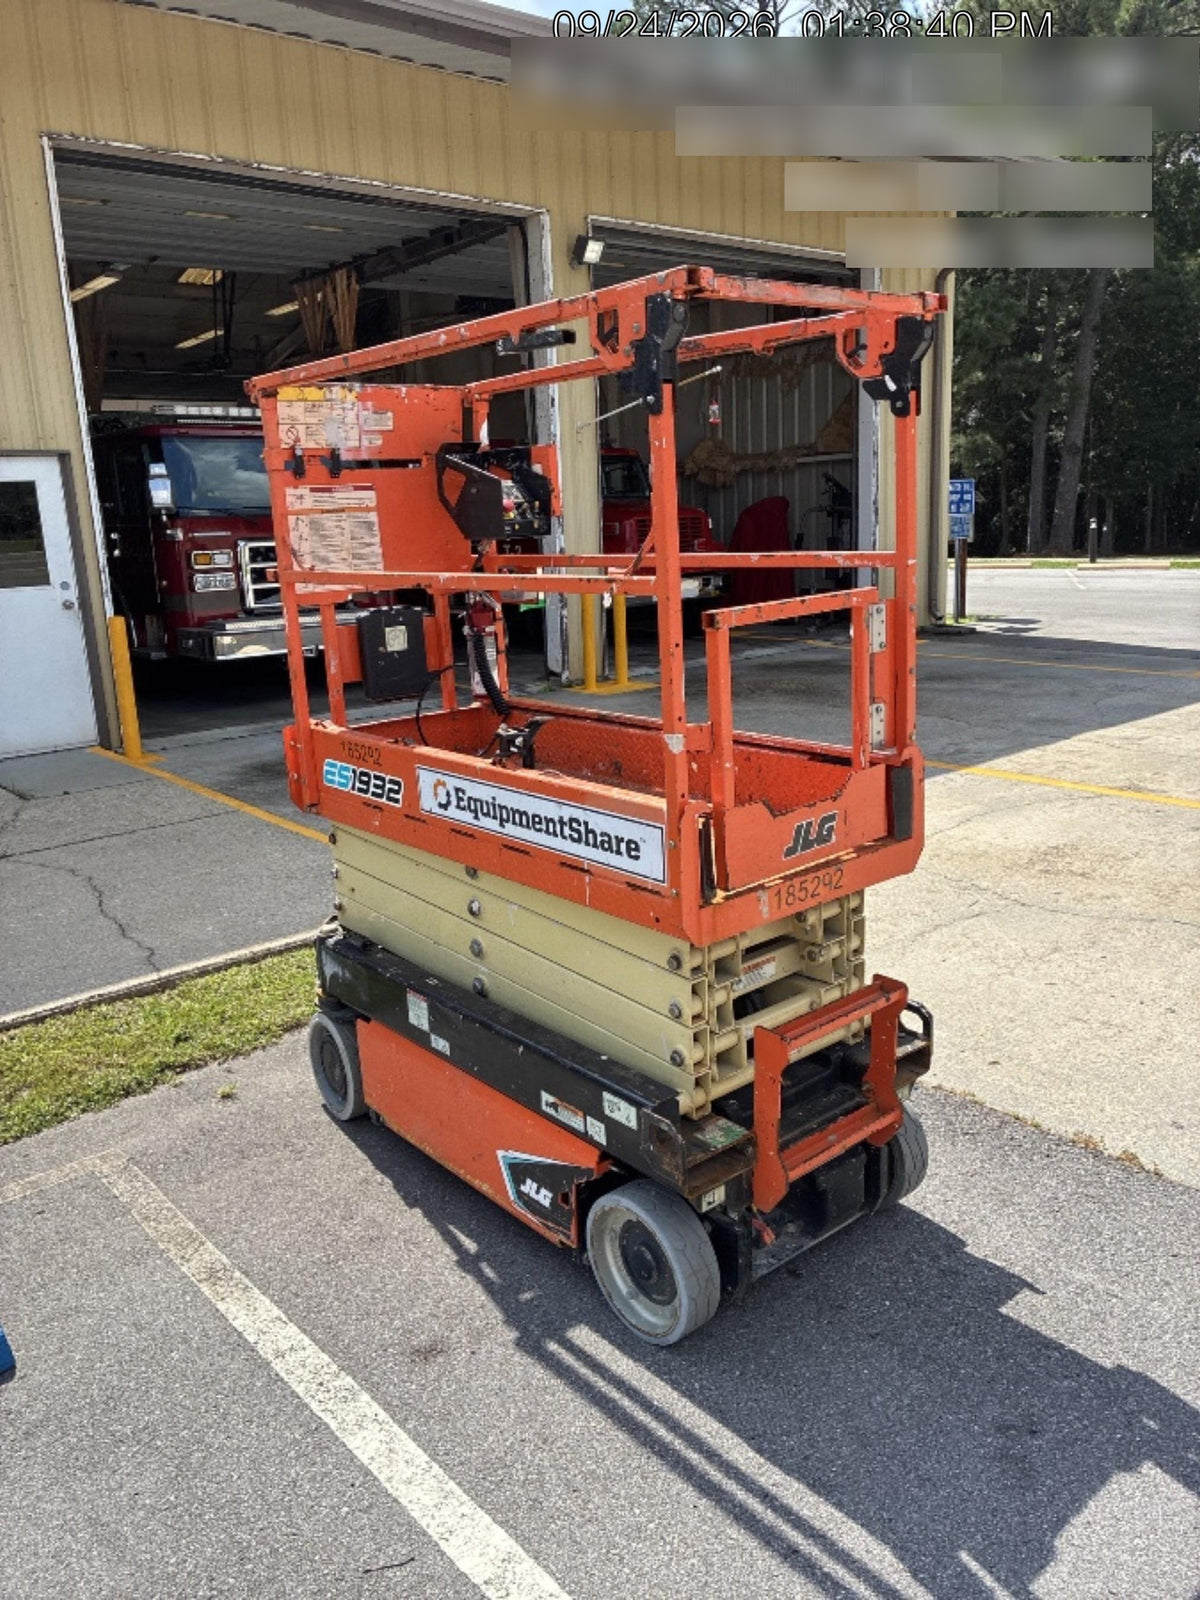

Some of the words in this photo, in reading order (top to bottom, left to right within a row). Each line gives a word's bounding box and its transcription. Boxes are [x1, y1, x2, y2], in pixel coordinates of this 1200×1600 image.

[323, 758, 404, 807] ES1932
[452, 786, 641, 861] EquipmentShare
[782, 811, 838, 859] JLG
[775, 868, 844, 910] 185292
[520, 1178, 553, 1208] JLG
